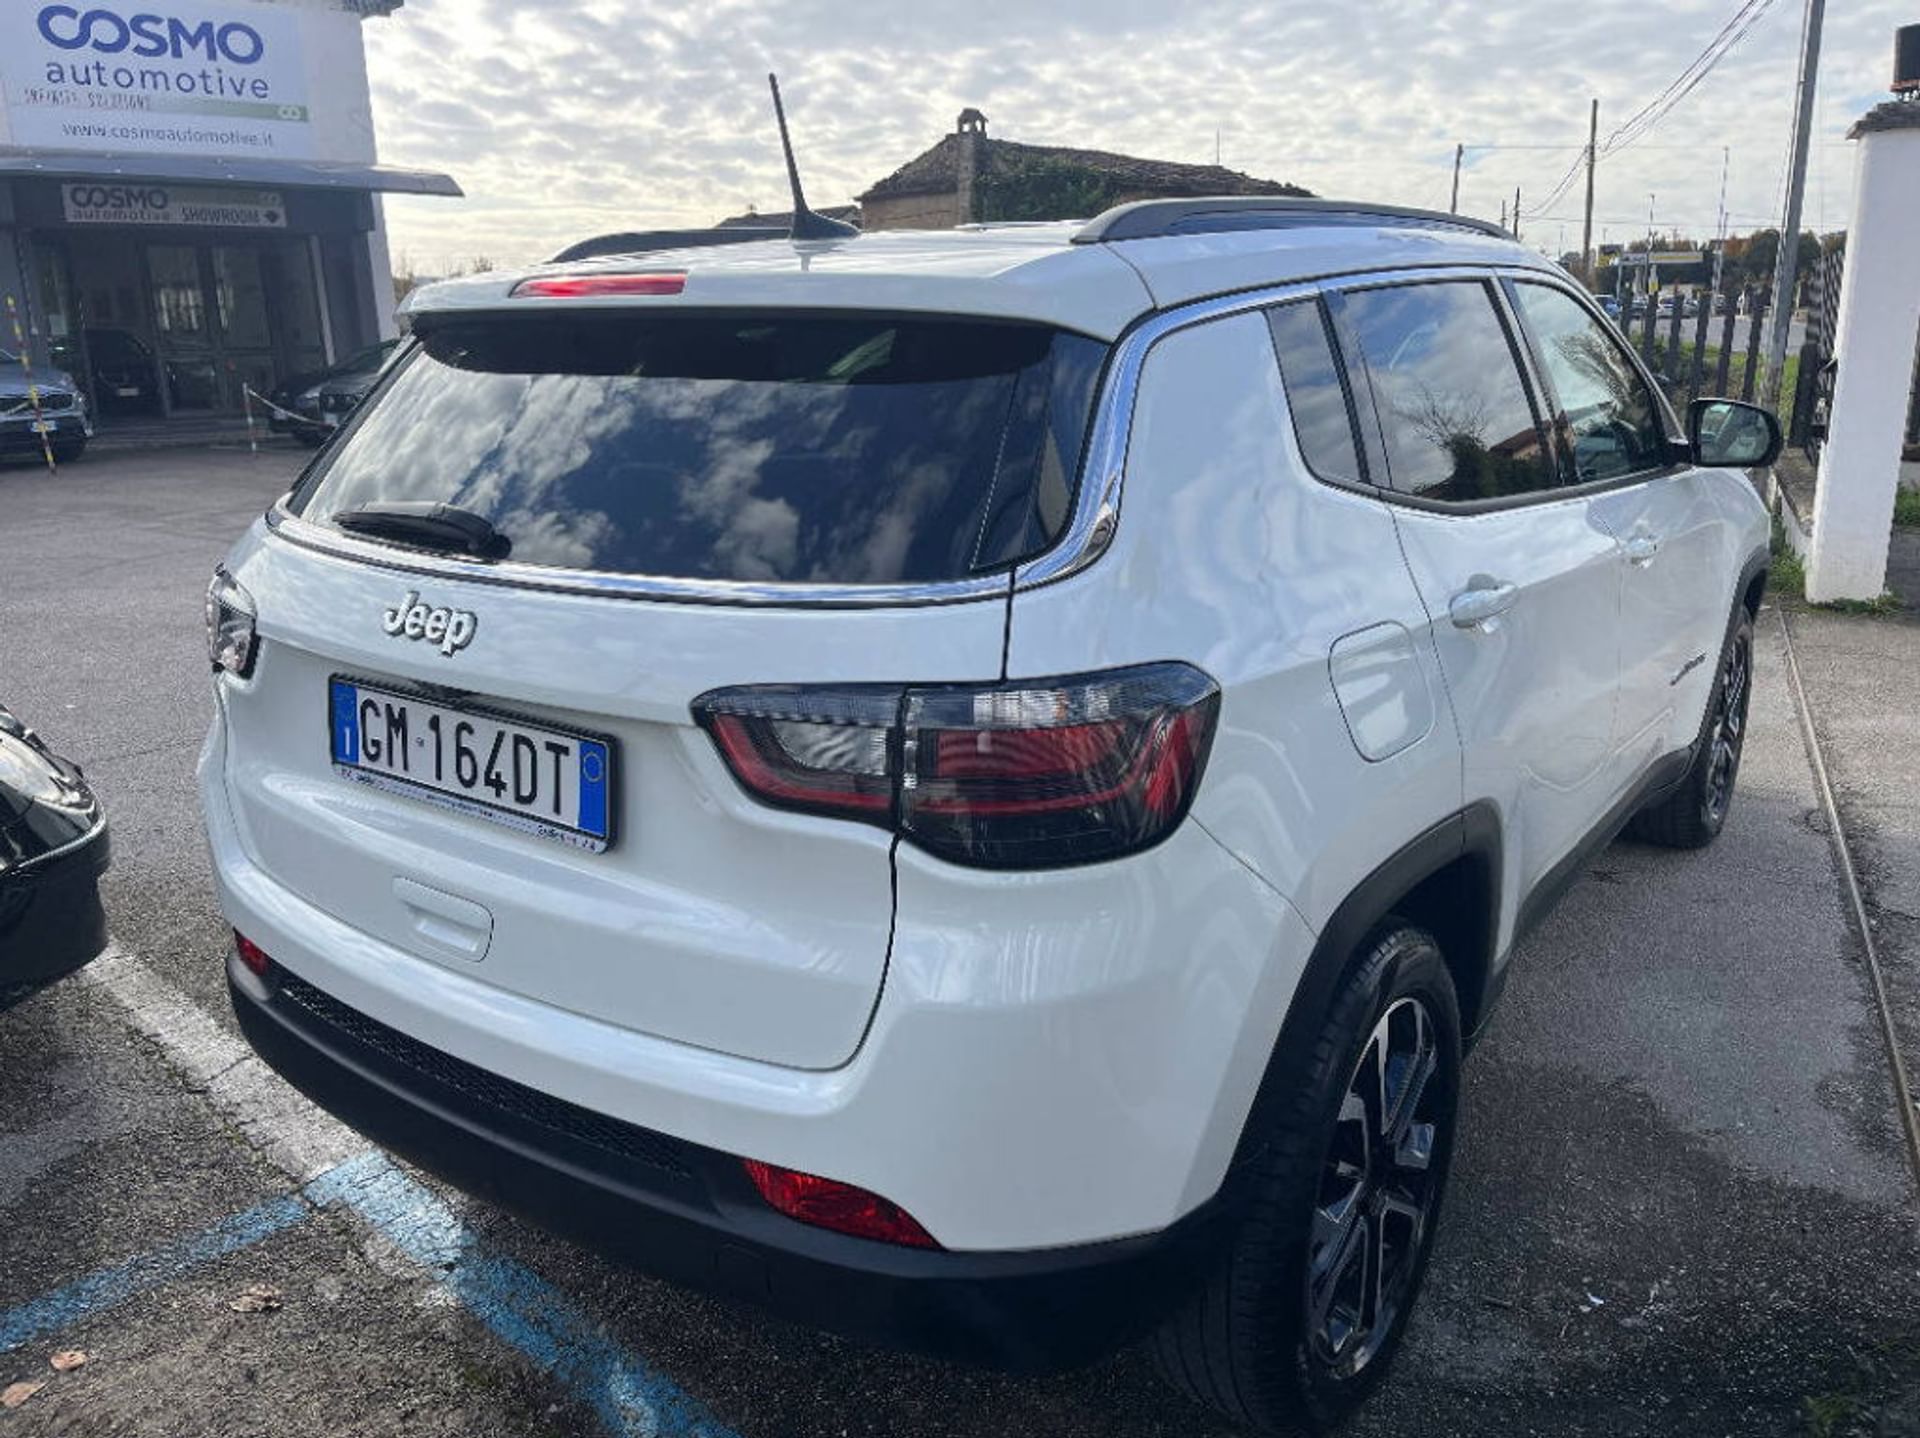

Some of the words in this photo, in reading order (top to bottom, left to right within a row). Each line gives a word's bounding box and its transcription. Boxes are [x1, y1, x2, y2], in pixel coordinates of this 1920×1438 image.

[37, 5, 264, 65] COSMO
[46, 60, 270, 99] automotive
[61, 122, 274, 147] www.cosmoautomotive.it
[70, 186, 168, 210] COSMO
[72, 207, 171, 222] automotive
[181, 206, 260, 225] SHOWROOM
[383, 590, 478, 658] Jeep
